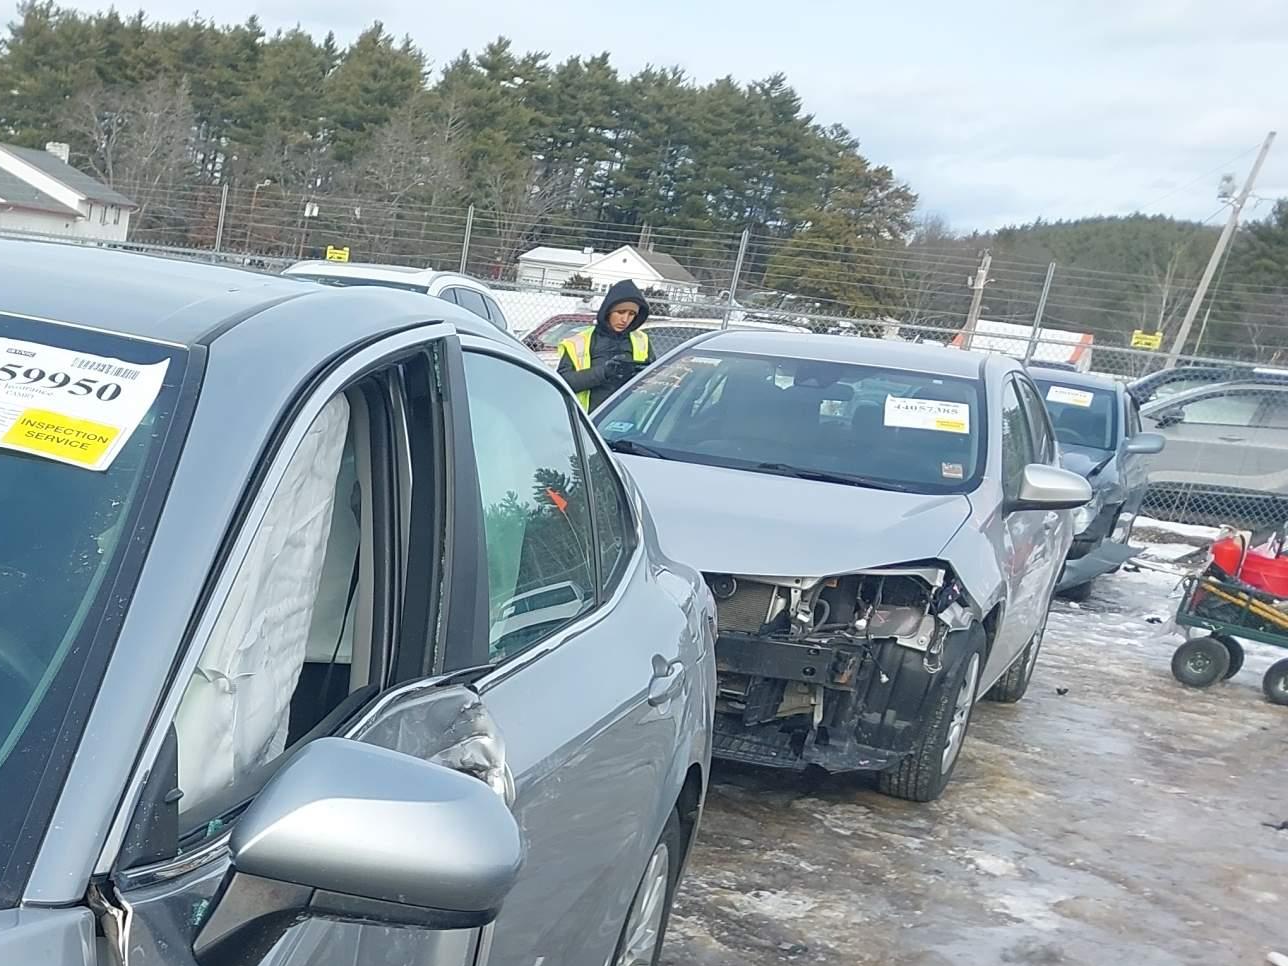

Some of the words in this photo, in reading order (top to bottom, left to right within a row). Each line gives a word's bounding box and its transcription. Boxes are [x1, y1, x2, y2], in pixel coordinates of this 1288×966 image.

[4, 382, 54, 396] Insurance
[21, 418, 109, 444] INSPECTION
[25, 431, 92, 451] SERVICE
